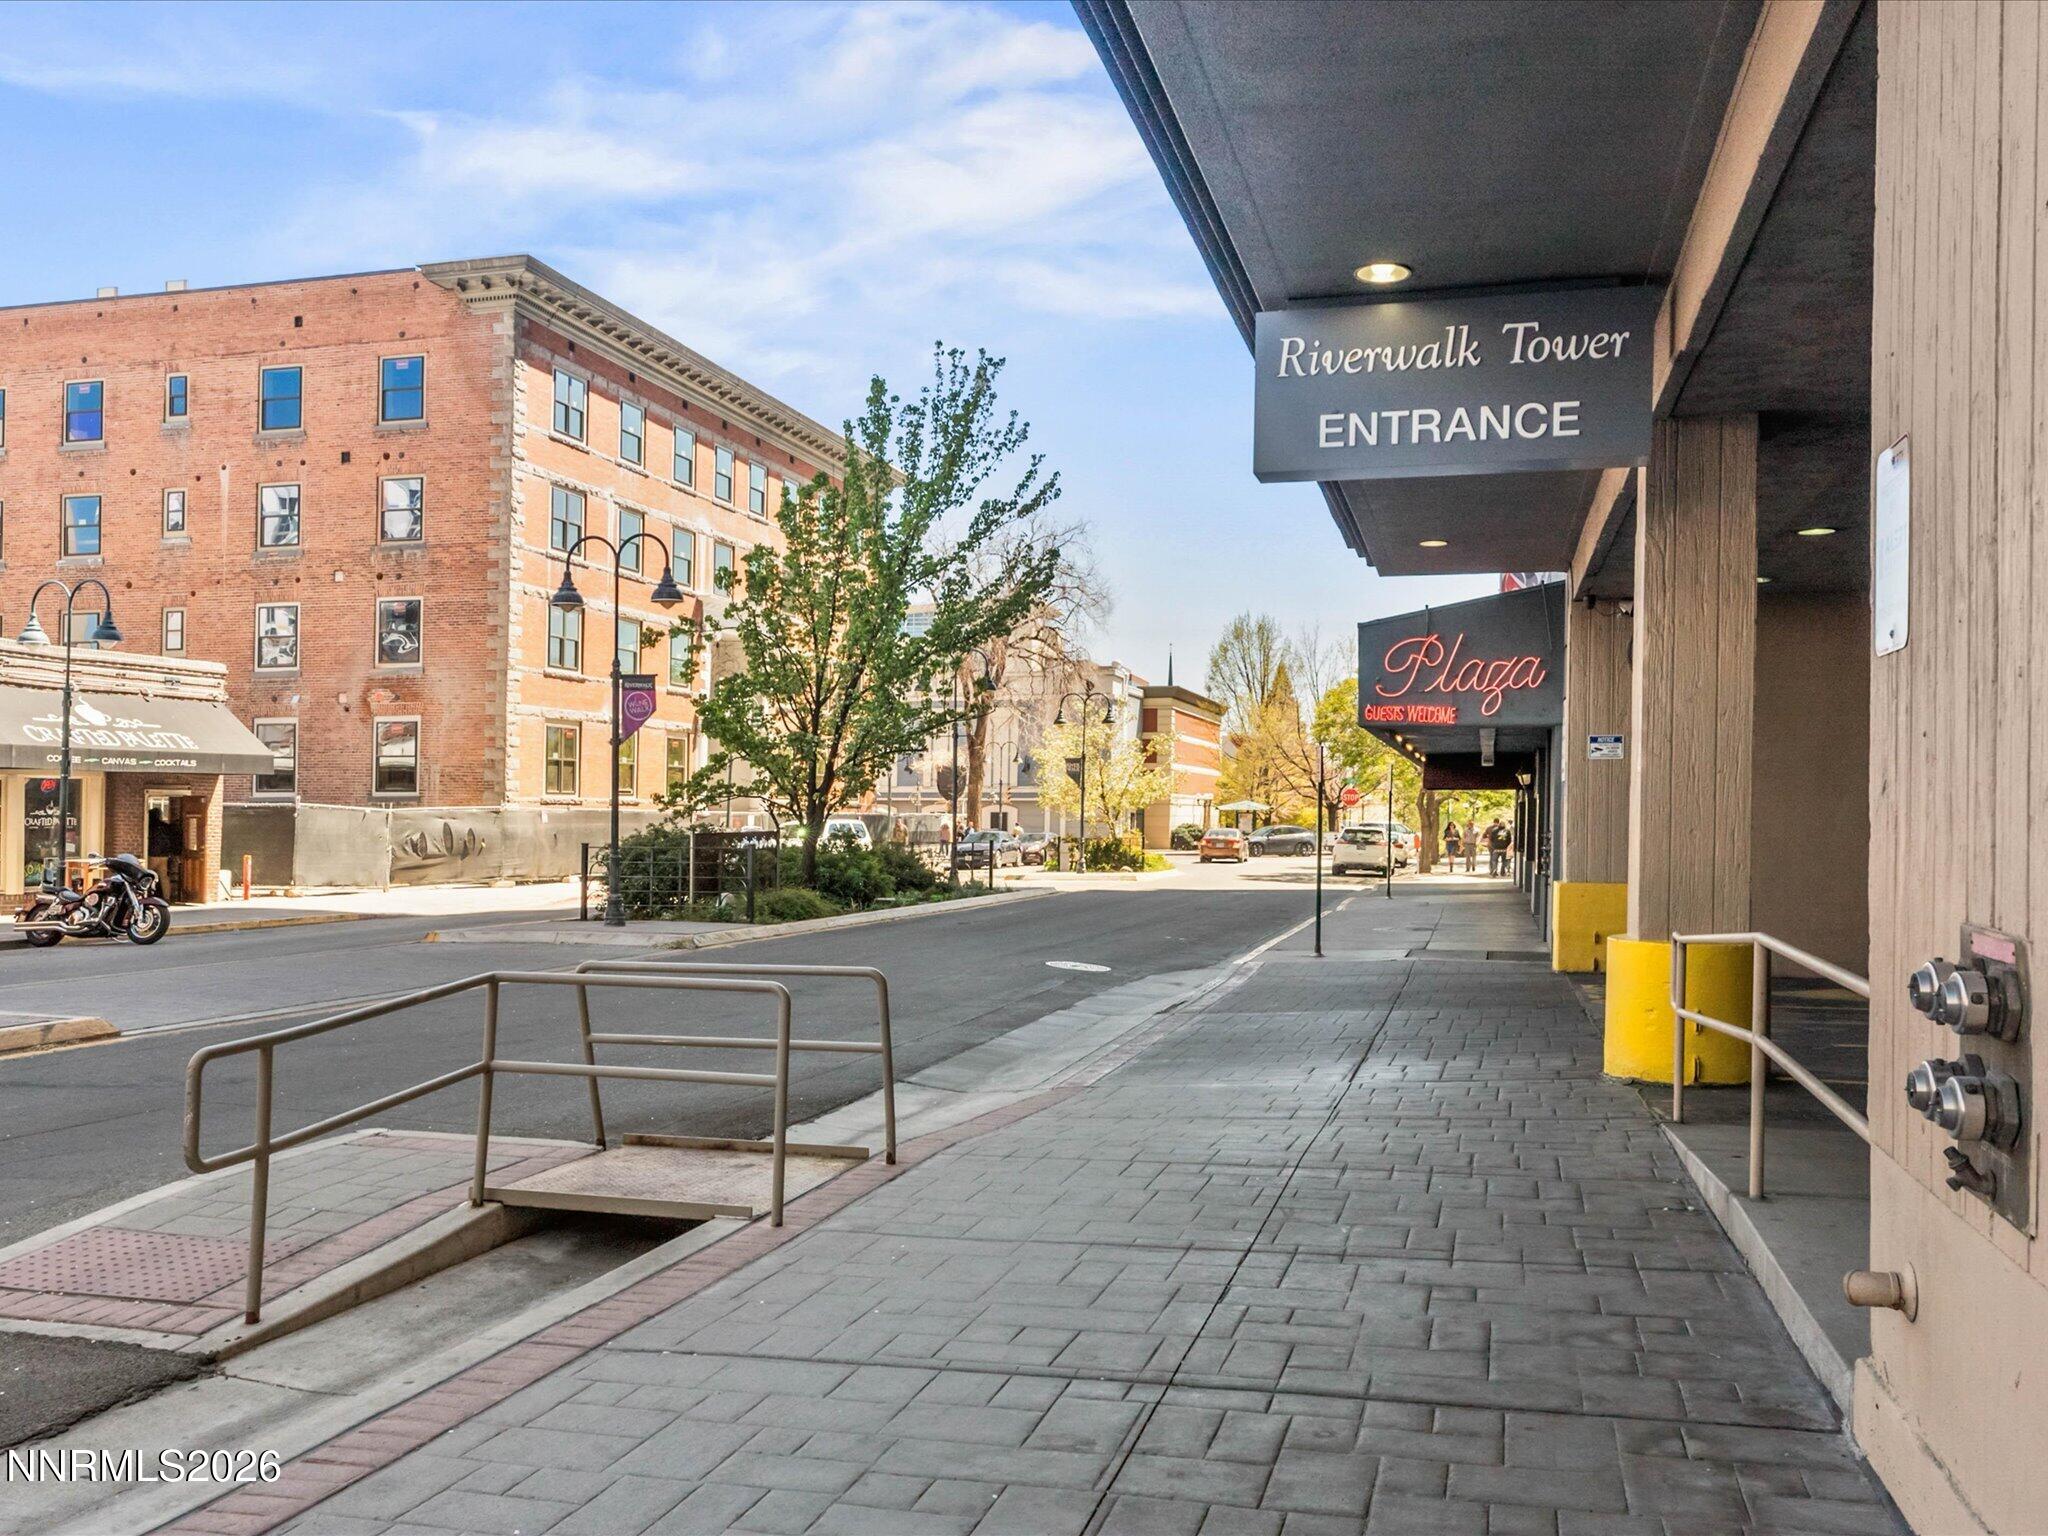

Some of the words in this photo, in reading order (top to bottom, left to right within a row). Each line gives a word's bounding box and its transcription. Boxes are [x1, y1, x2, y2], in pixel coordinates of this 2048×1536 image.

[1277, 325, 1481, 378] Riverwalk
[1502, 322, 1630, 364] Tower
[1319, 401, 1580, 448] ENTRANCE
[1376, 633, 1546, 716] Plaza
[1365, 704, 1404, 721] GUESTS
[1407, 705, 1456, 723] WELCOME
[102, 757, 137, 765] CANVAS
[154, 759, 197, 768] COCKTAILS
